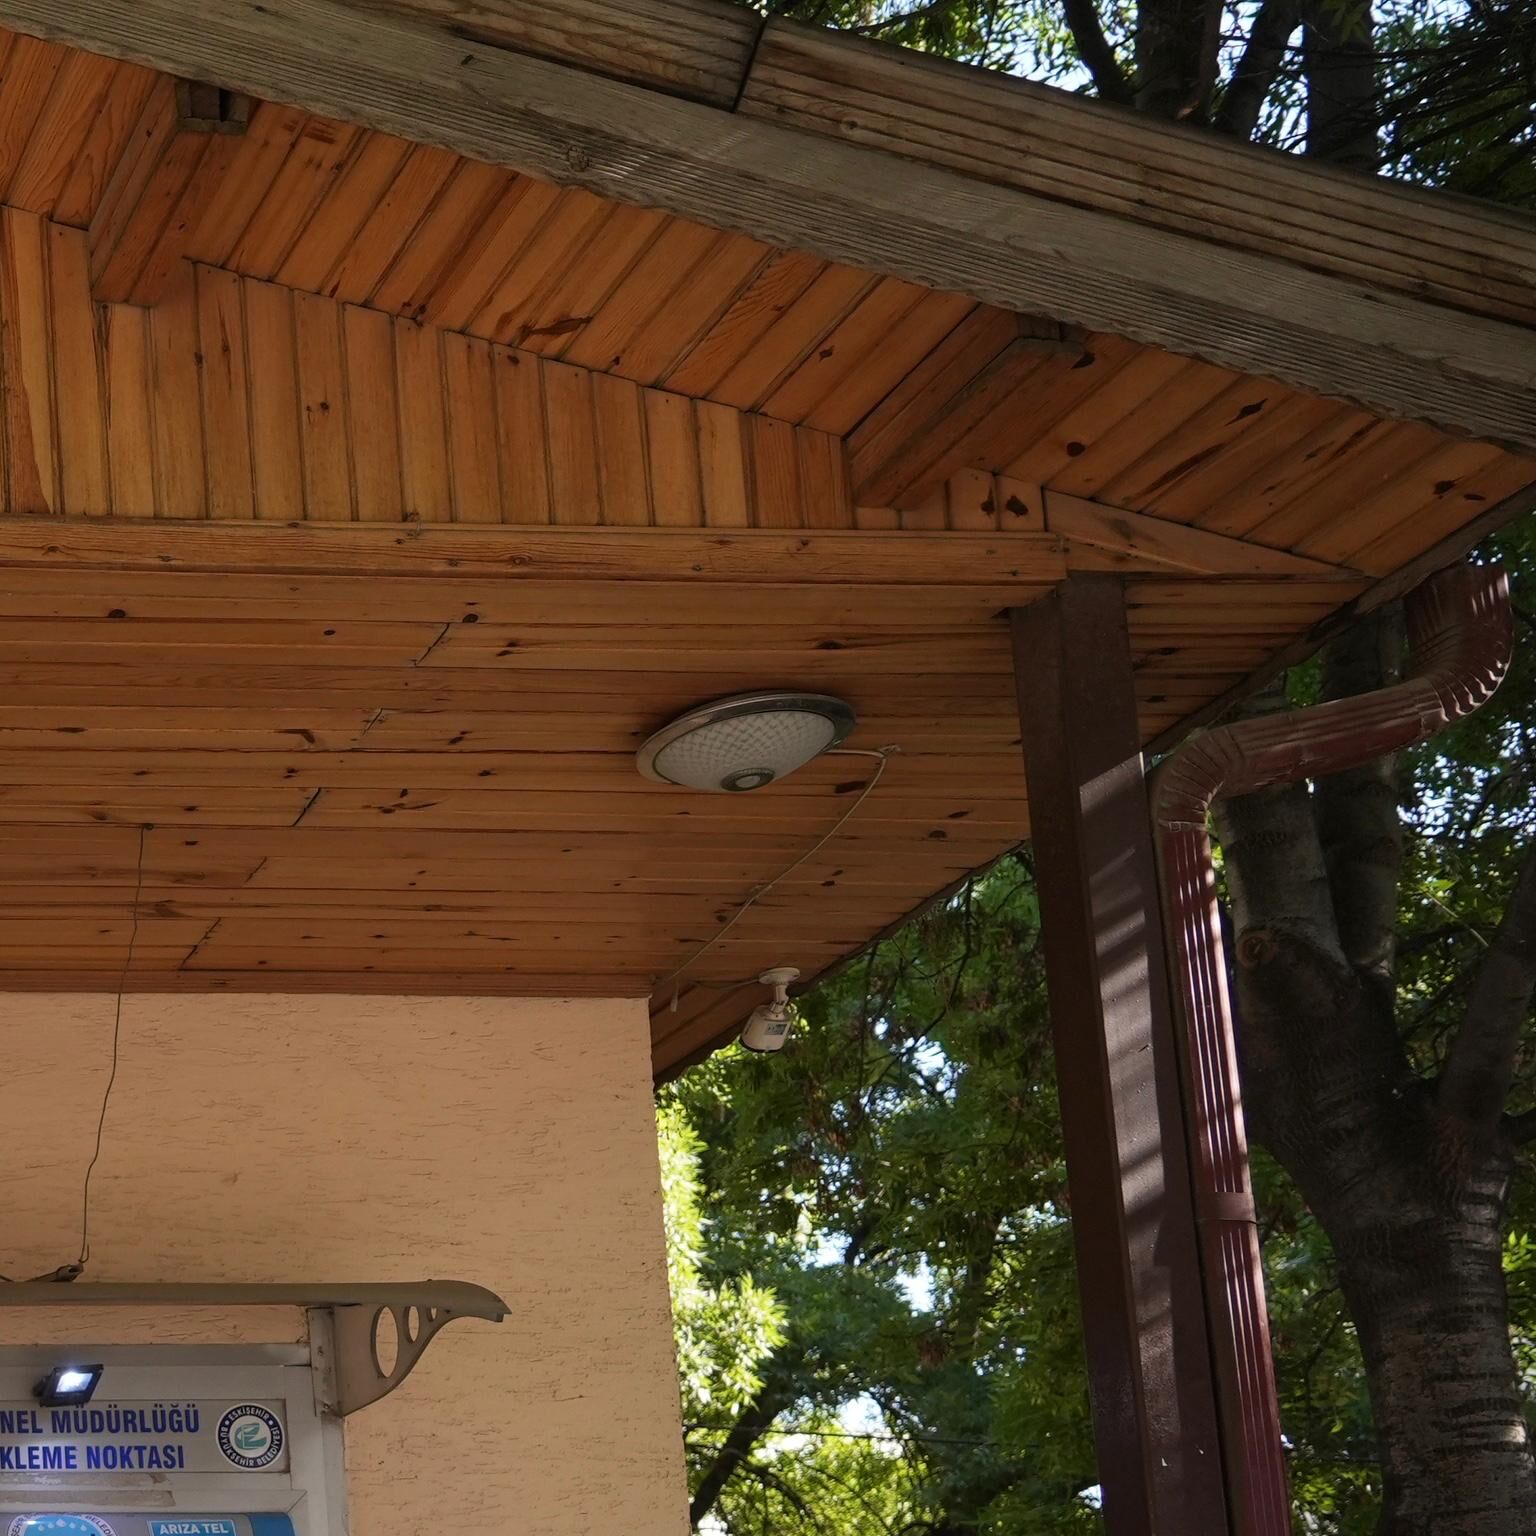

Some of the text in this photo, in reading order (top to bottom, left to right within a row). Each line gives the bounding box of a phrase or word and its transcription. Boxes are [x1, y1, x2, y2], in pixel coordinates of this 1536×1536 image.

[50, 1403, 200, 1434] MÜDÜRLÜĞÜ
[86, 1444, 185, 1469] NOKTASI
[159, 1523, 230, 1535] ARIZA TEL
